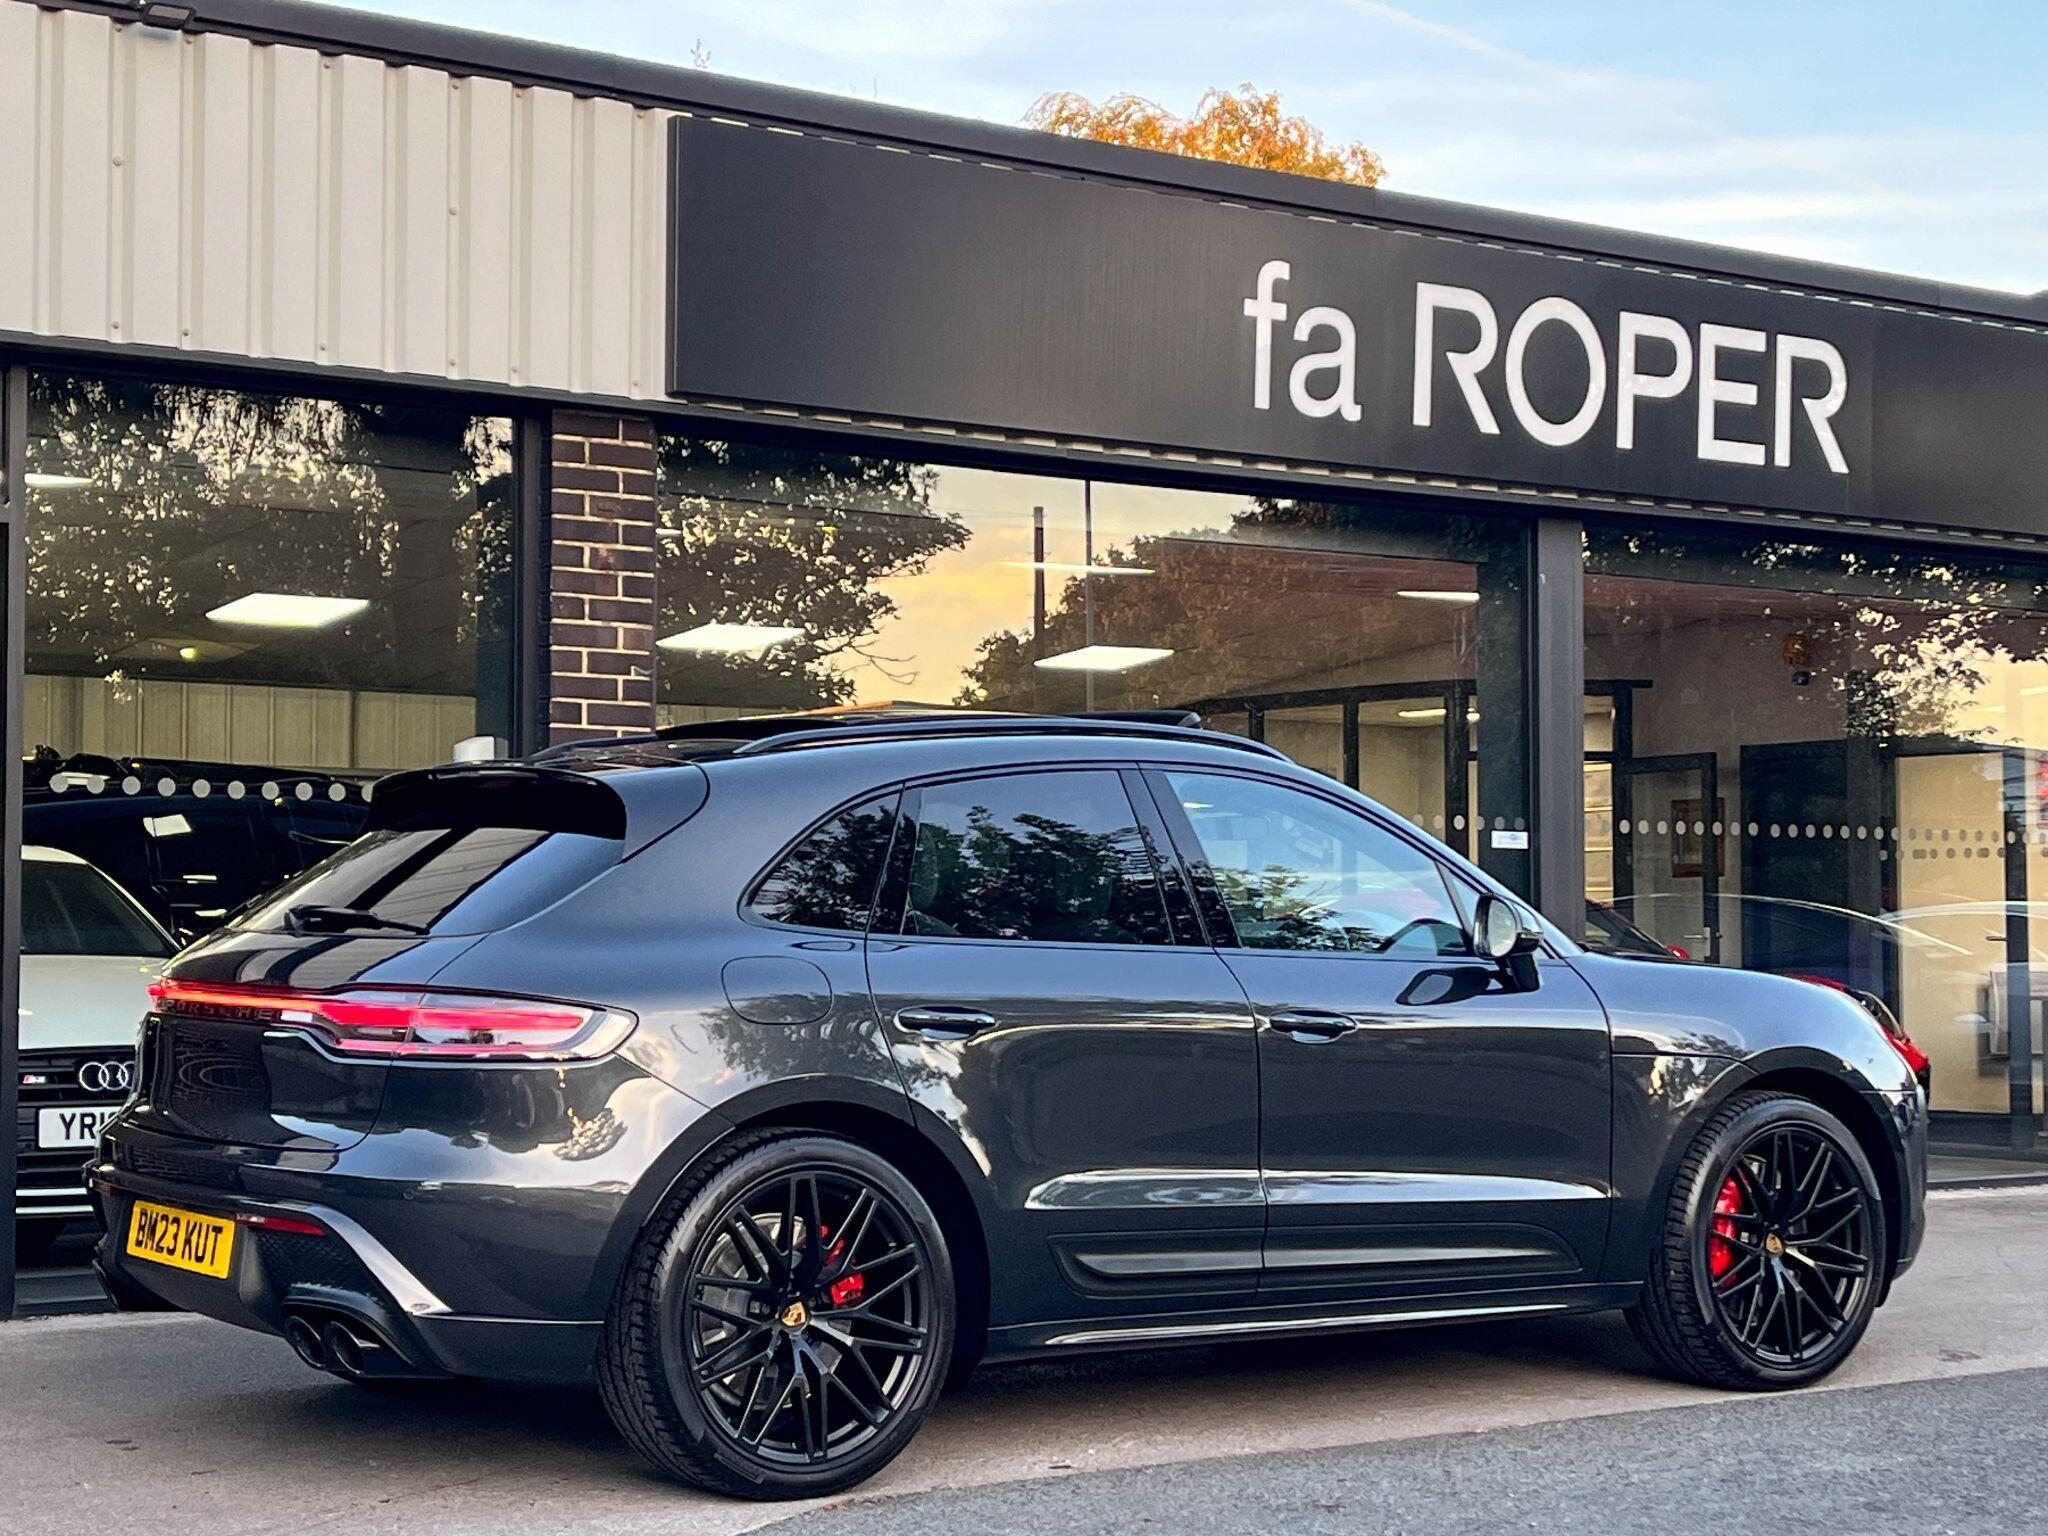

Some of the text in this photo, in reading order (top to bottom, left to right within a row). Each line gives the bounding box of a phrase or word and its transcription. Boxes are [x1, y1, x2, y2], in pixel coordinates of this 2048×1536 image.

[1243, 260, 1850, 474] fa ROPER
[59, 1111, 119, 1140] YR
[181, 1219, 223, 1266] KUT
